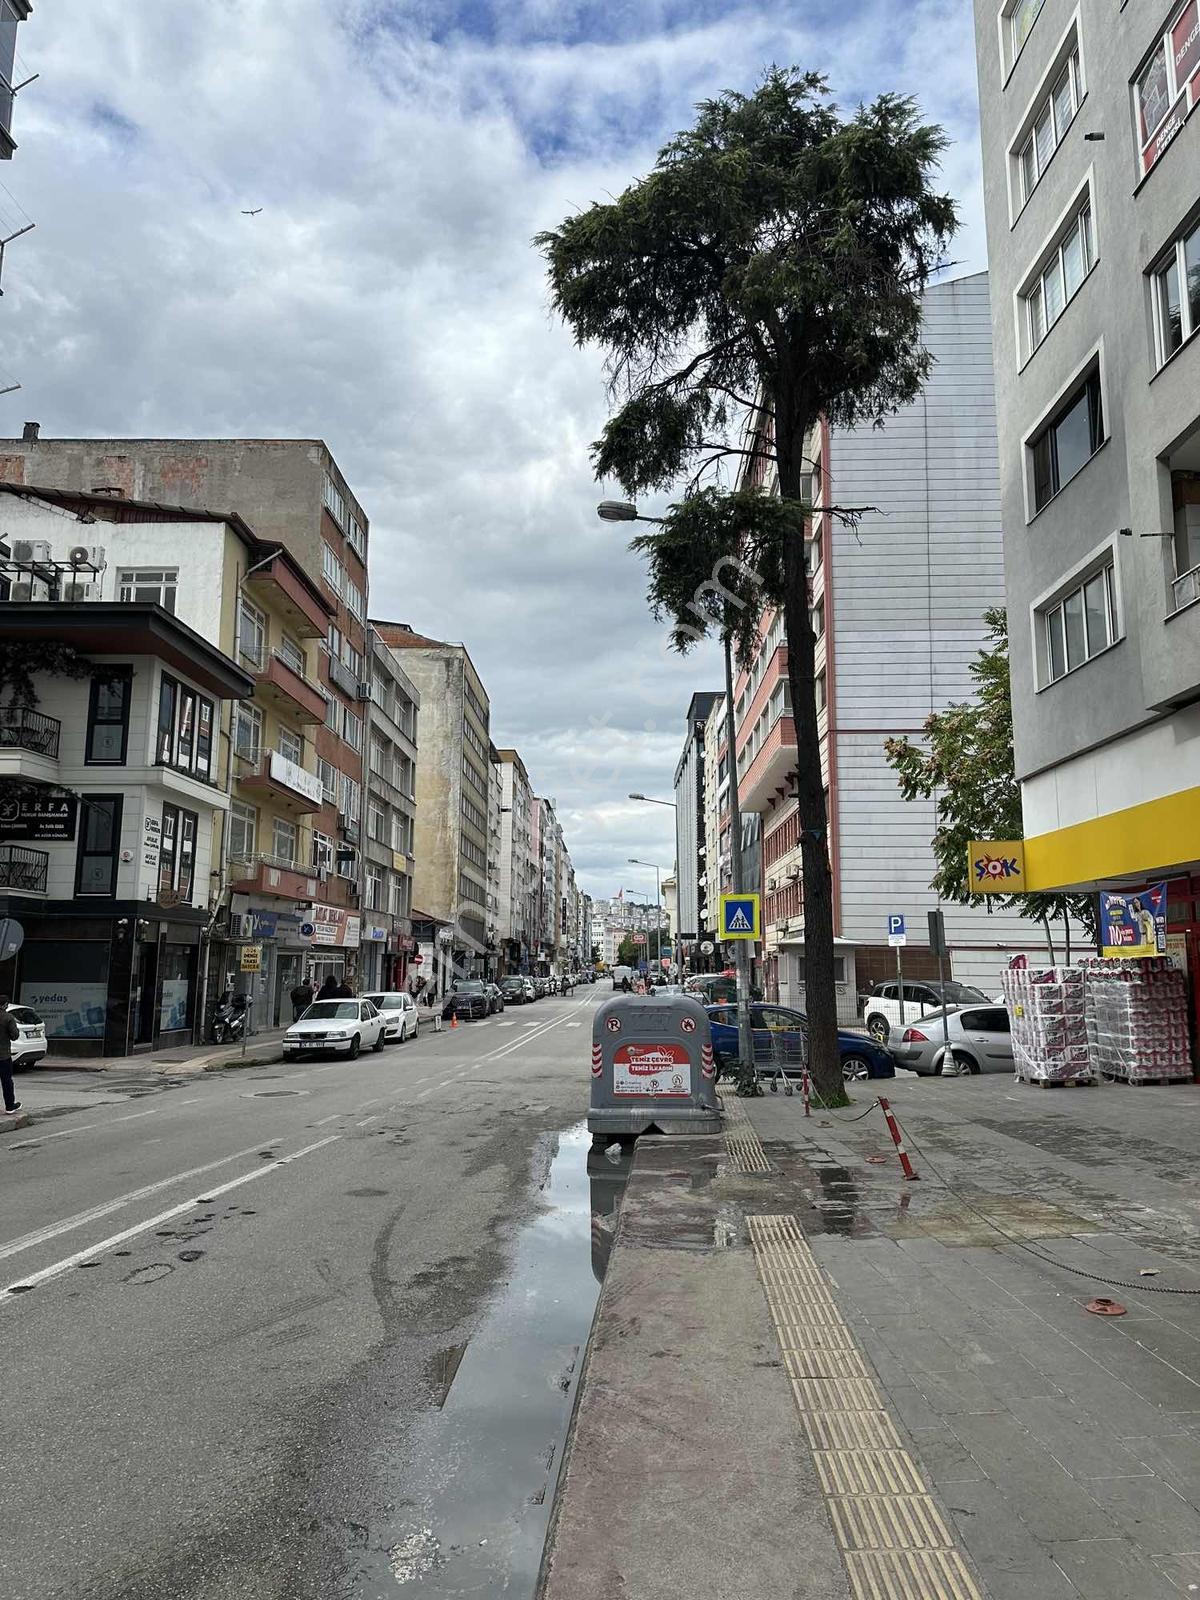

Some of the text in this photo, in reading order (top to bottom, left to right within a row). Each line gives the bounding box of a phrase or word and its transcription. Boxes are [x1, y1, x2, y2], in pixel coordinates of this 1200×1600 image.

[21, 803, 69, 812] ERFA
[974, 857, 1021, 882] ŞOK
[891, 916, 902, 933] P
[631, 1055, 651, 1063] TEMİZ
[631, 1064, 649, 1072] TEMİZ
